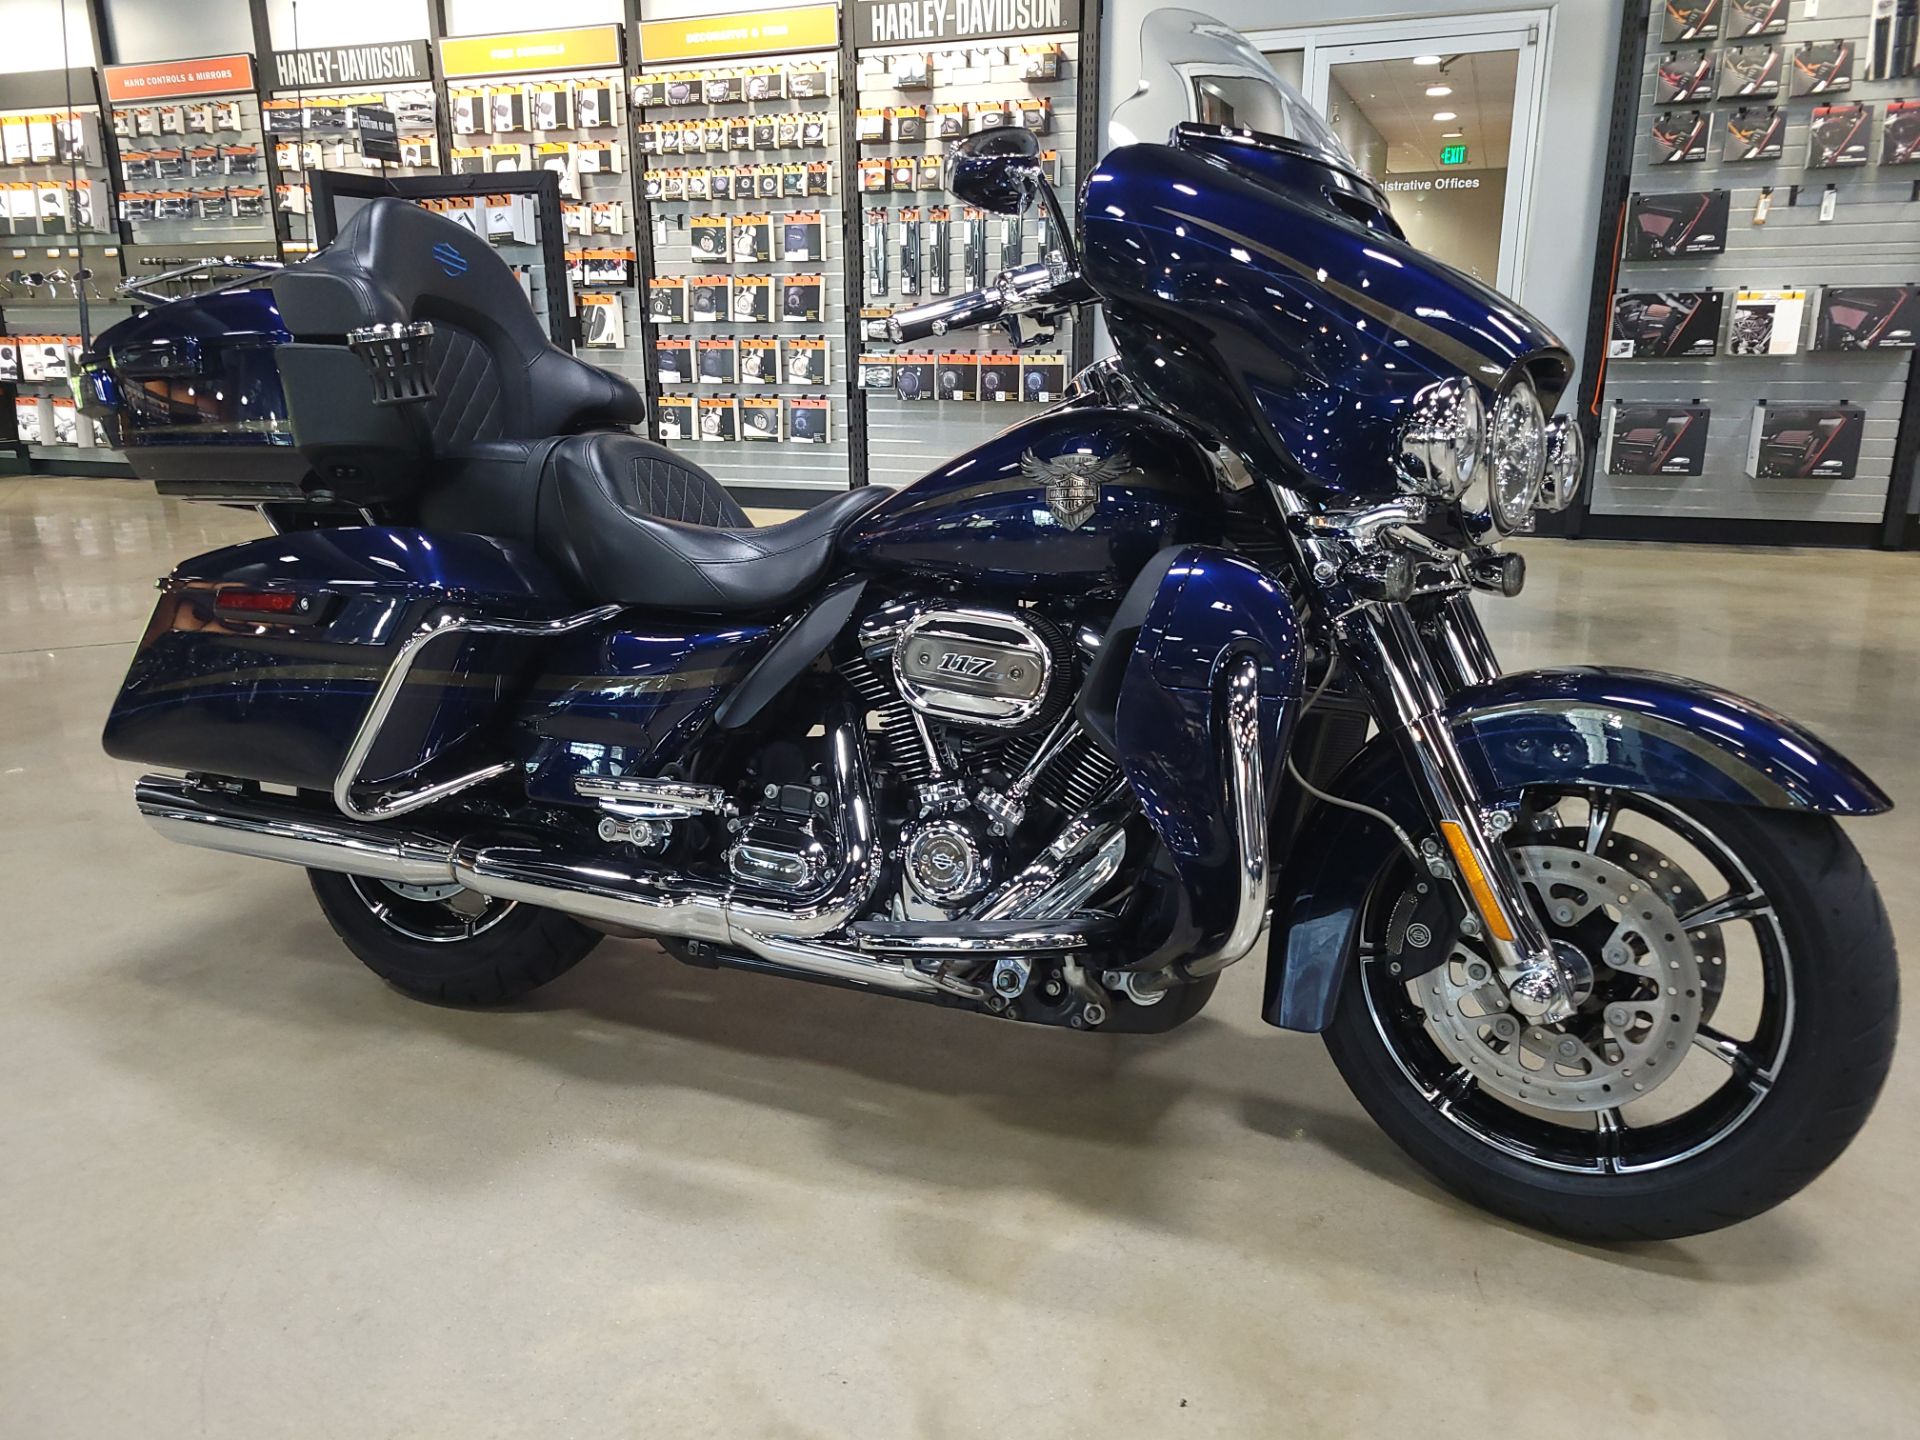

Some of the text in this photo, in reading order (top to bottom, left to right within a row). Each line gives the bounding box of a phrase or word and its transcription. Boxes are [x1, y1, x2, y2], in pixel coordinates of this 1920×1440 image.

[872, 0, 1060, 42] HARLEY-DAVIDSON
[276, 44, 415, 86] HARLEY-DAVIDSON
[124, 78, 145, 88] HAND
[146, 74, 186, 86] CONTROLS
[195, 69, 233, 81] MIRRORS
[1444, 147, 1466, 164] EXIT
[1379, 178, 1480, 192] nistrative Offices
[937, 652, 997, 677] 117
